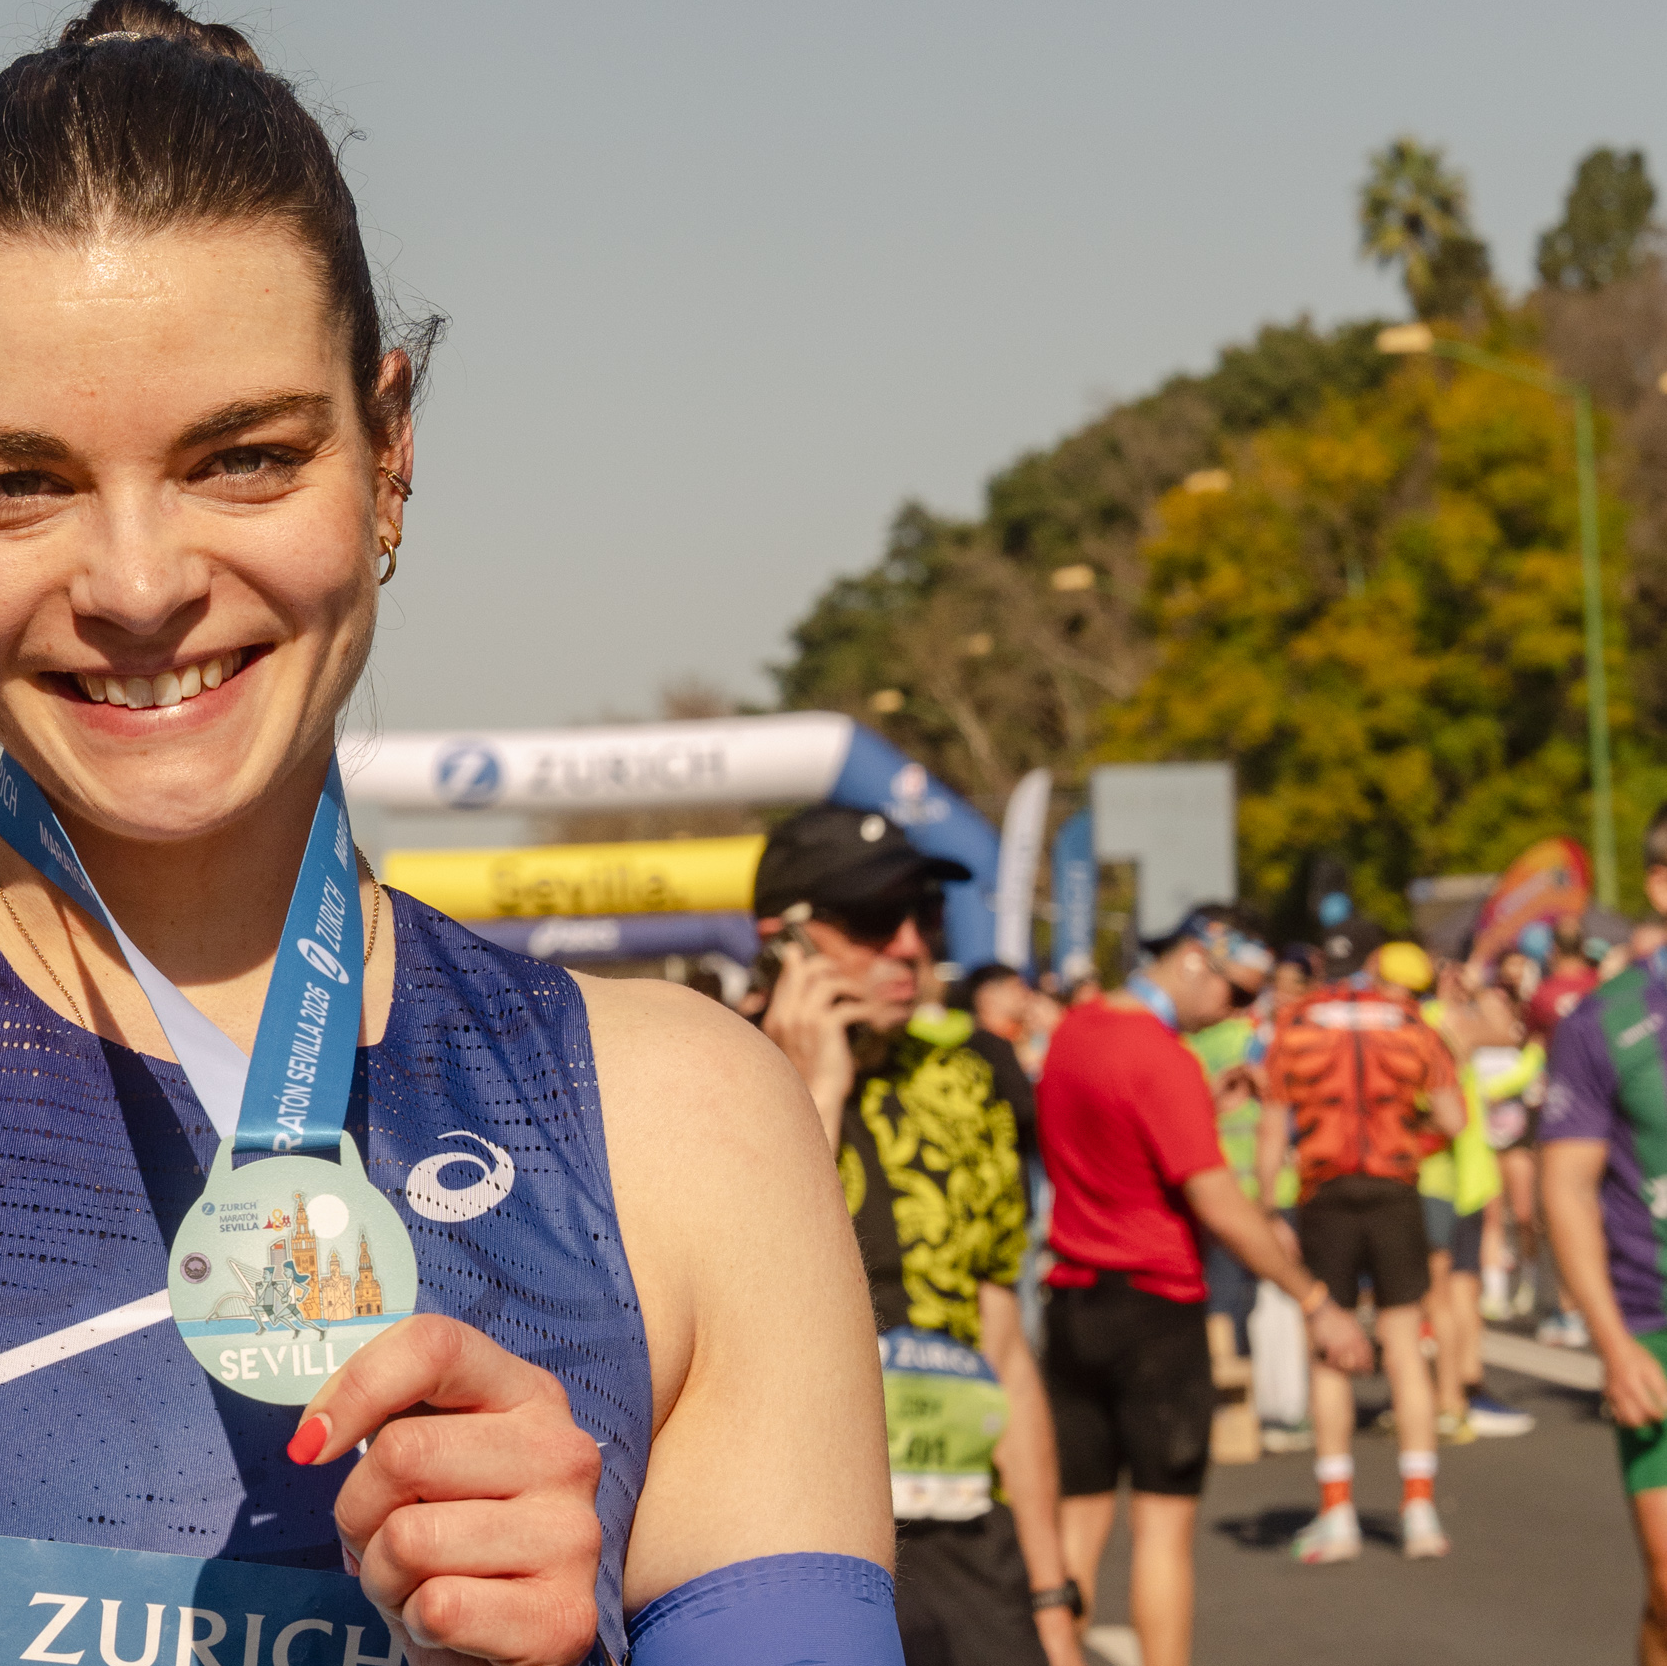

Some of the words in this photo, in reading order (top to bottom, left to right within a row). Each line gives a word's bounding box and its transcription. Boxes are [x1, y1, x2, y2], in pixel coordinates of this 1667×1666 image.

[315, 875, 346, 954] ZURICH
[299, 981, 331, 1026] 2026
[286, 1021, 325, 1084] SEVILLA
[272, 1082, 313, 1153] RATÓN
[219, 1213, 259, 1223] MARATÓN
[219, 1223, 260, 1233] SEVILLA
[220, 1202, 257, 1212] ZURICH
[219, 1342, 365, 1382] SEVILL
